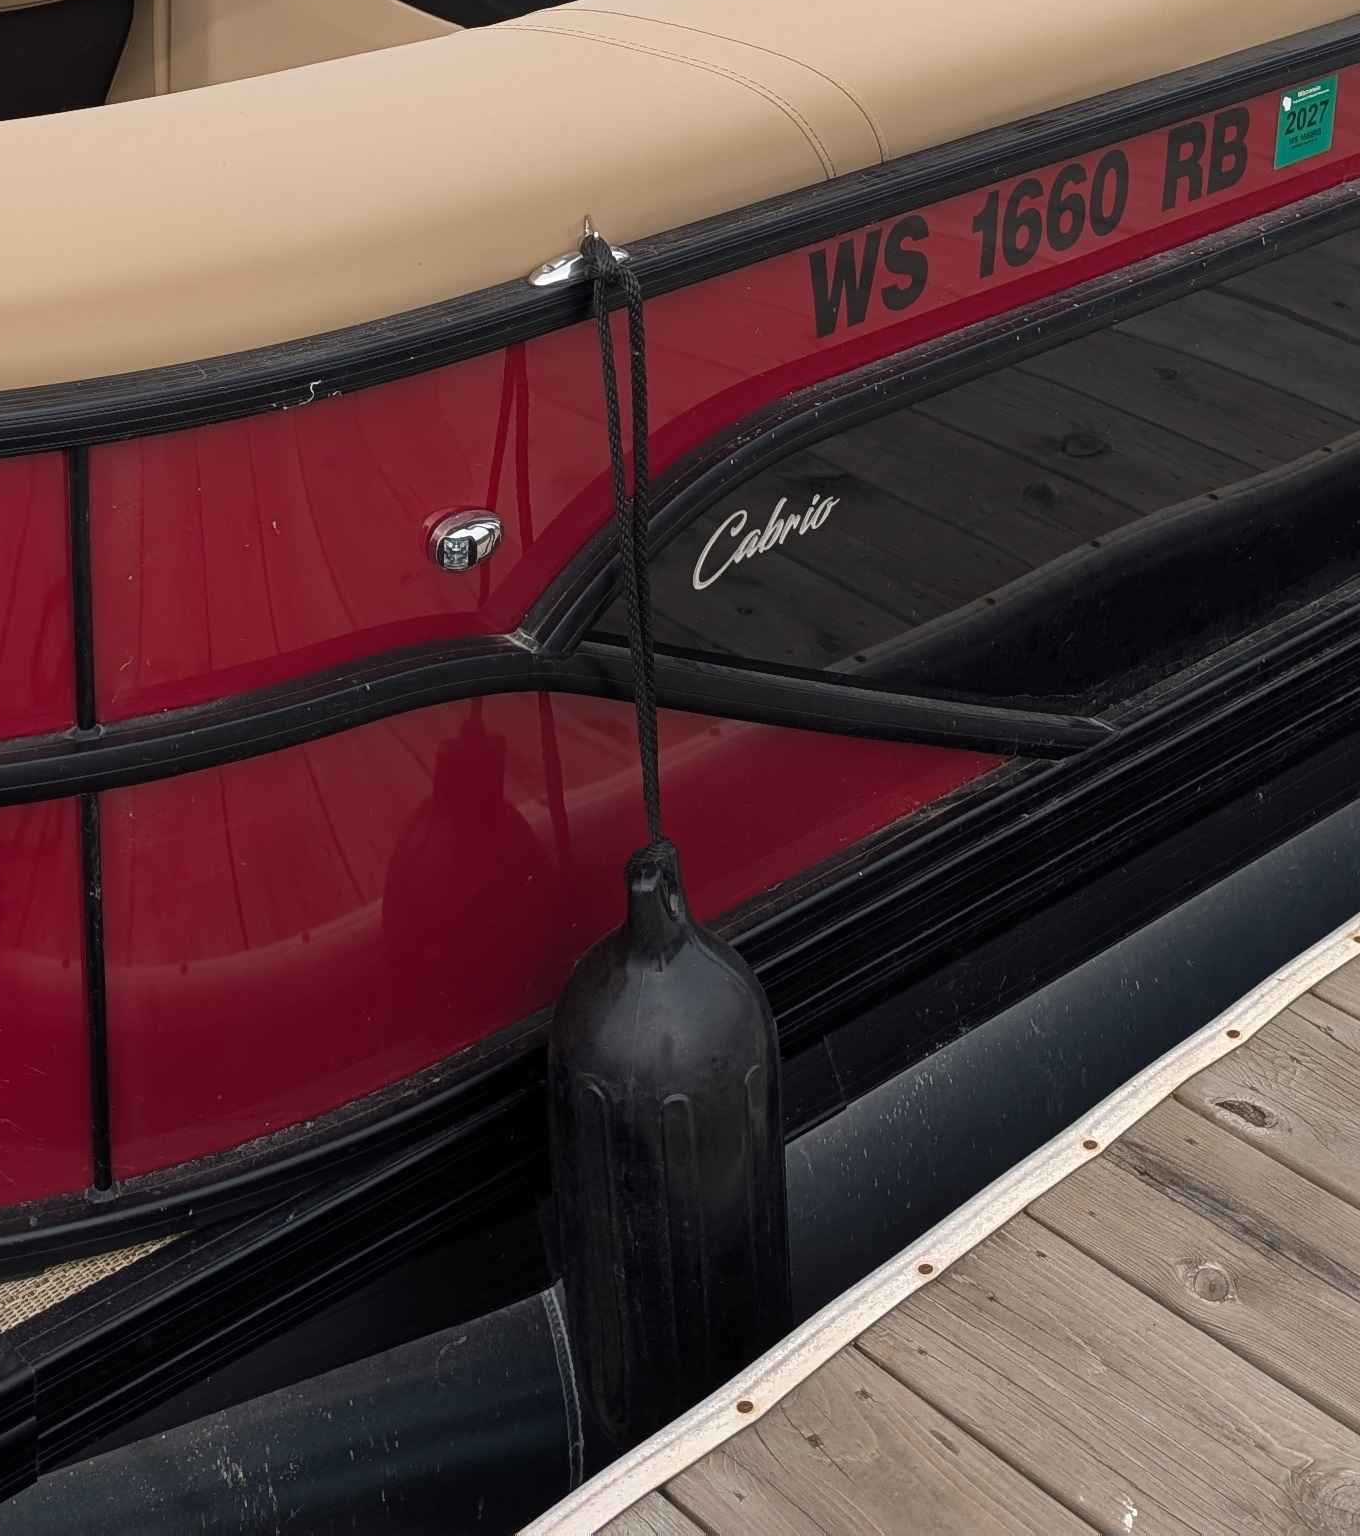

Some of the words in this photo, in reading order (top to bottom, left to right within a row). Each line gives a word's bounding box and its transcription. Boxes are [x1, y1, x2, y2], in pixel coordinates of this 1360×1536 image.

[1284, 99, 1330, 135] 2027
[809, 214, 930, 338] WS
[971, 149, 1129, 280] 1660
[1161, 105, 1250, 212] RB
[693, 493, 840, 590] Cabrio
